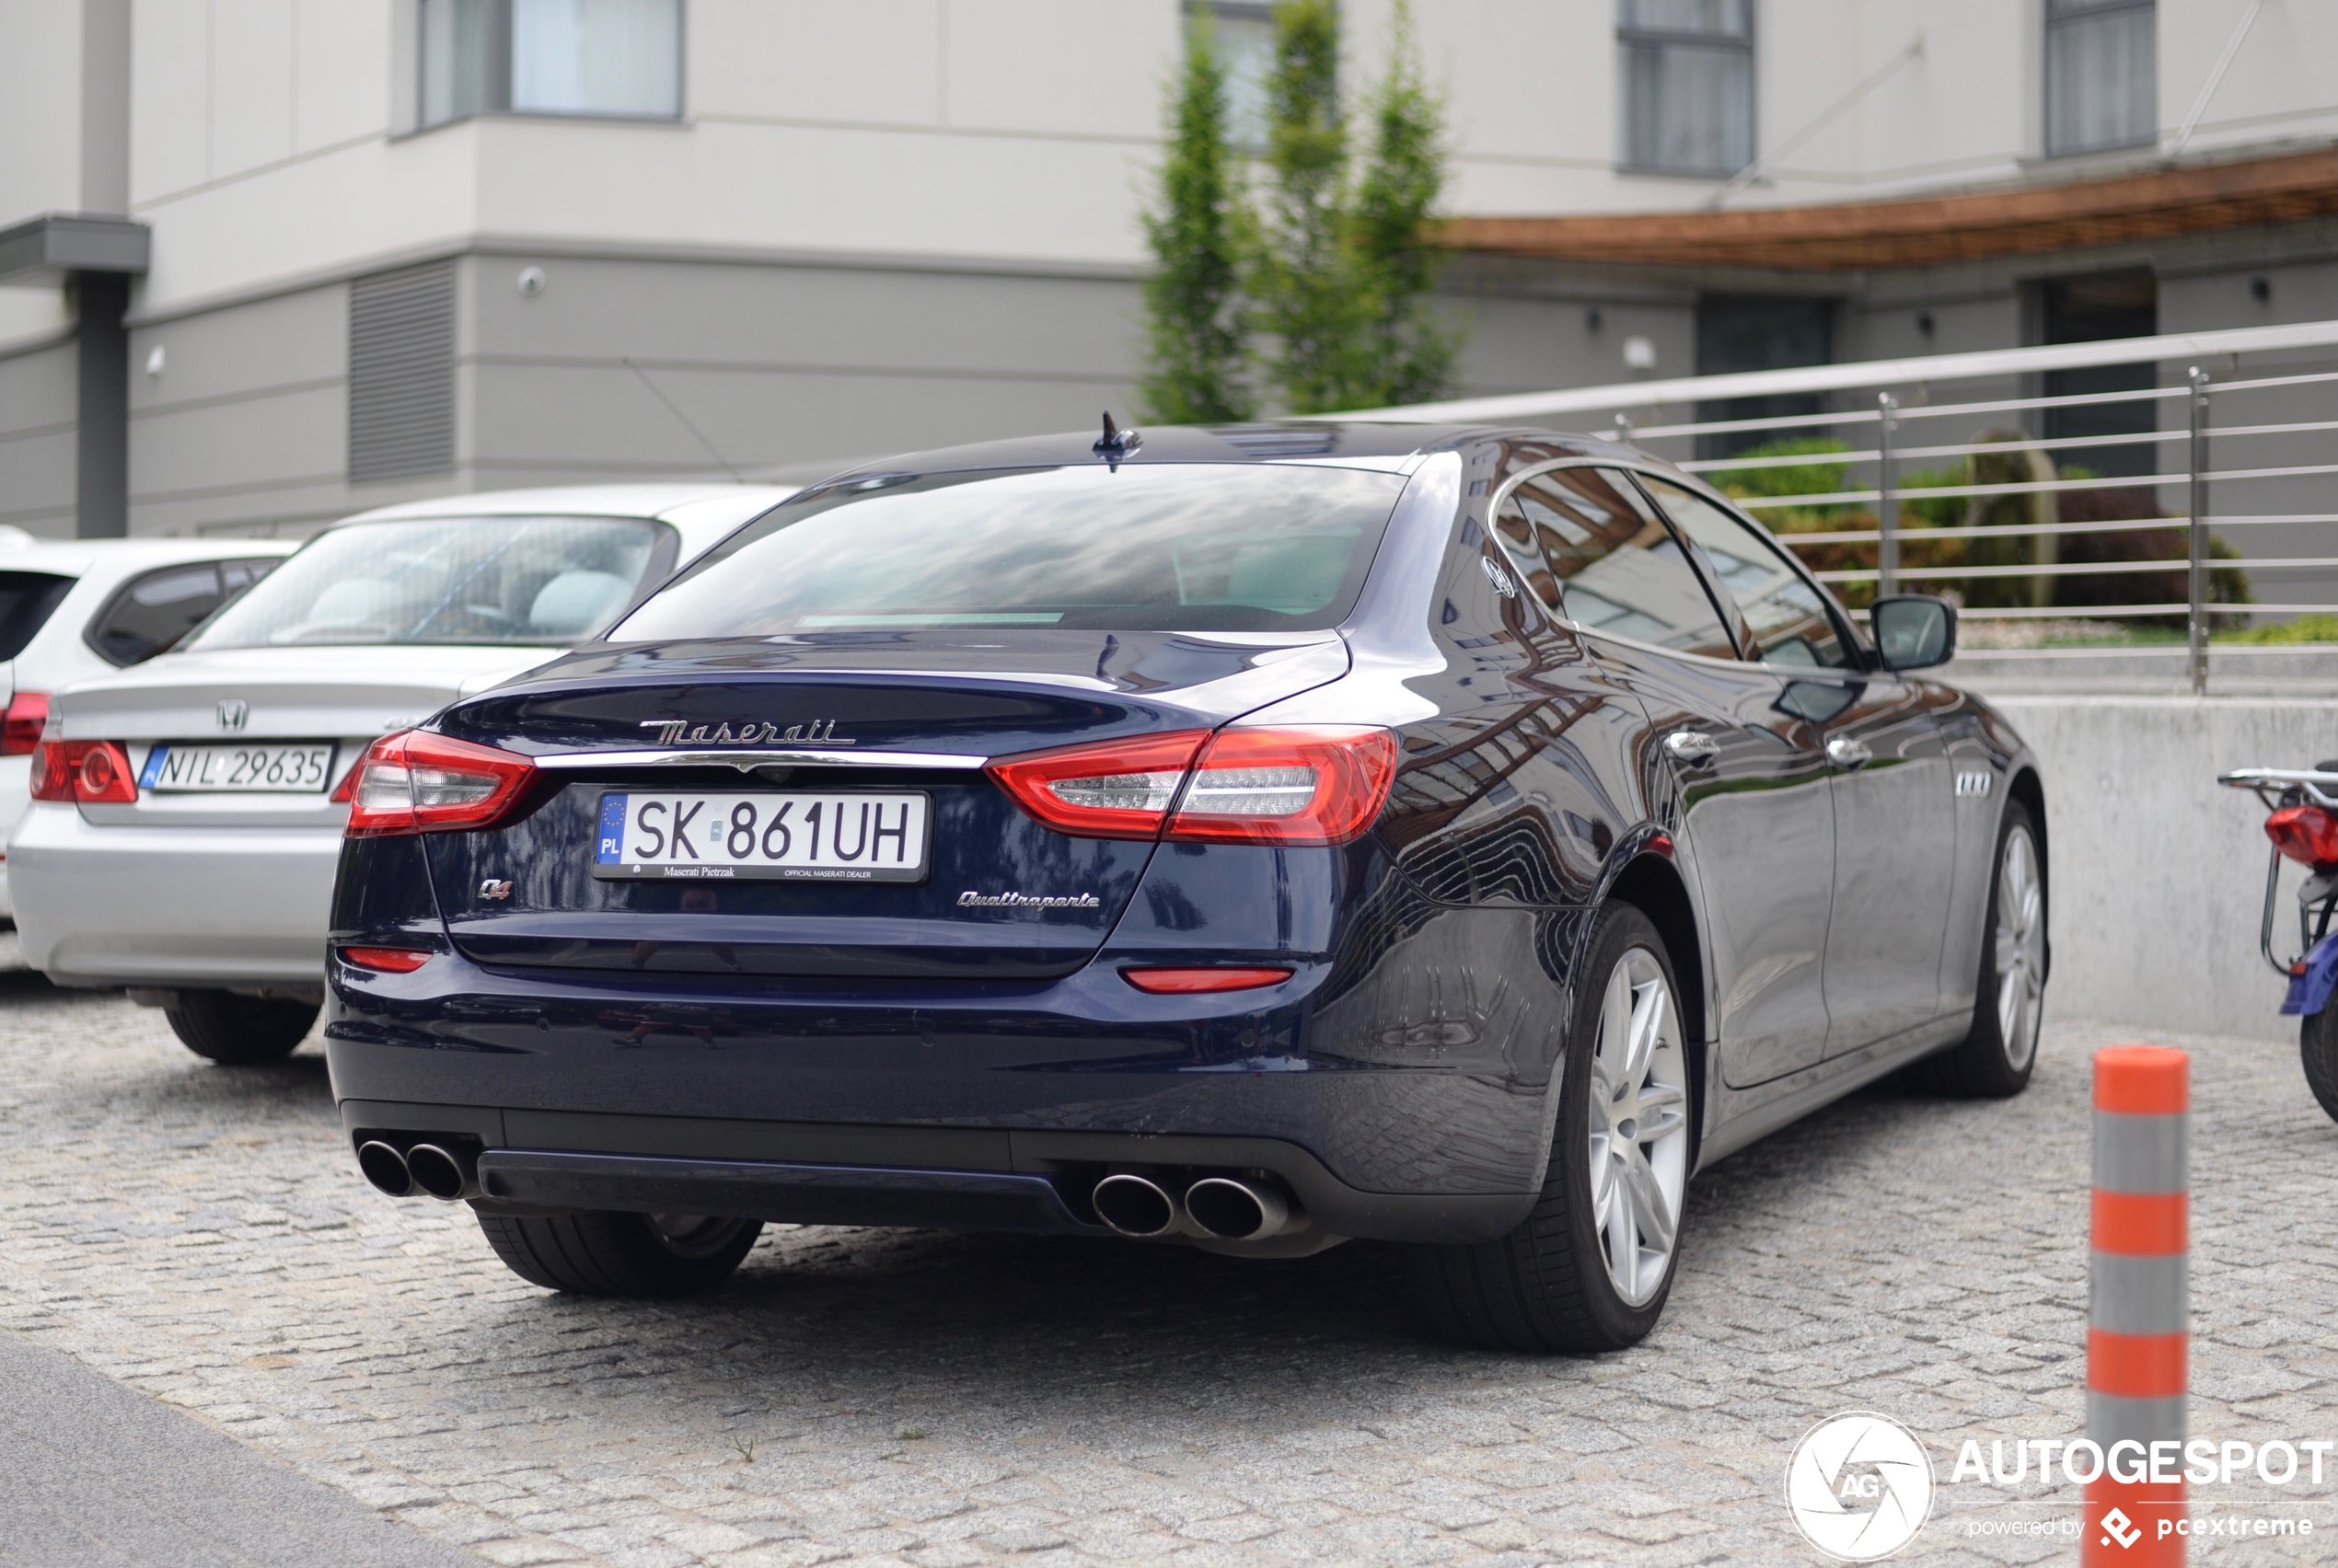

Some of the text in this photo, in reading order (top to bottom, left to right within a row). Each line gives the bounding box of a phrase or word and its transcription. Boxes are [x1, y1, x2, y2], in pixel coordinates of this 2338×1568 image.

[640, 720, 856, 745] Maserati
[159, 749, 326, 783] NIL 29635
[634, 801, 909, 862] SK 861UH
[601, 838, 619, 855] PL
[664, 866, 735, 877] Maserati Pietrzak
[813, 870, 845, 878] MASERATI
[846, 870, 872, 879] DEALER
[478, 879, 513, 899] Q4
[957, 891, 1100, 911] Quattroporte
